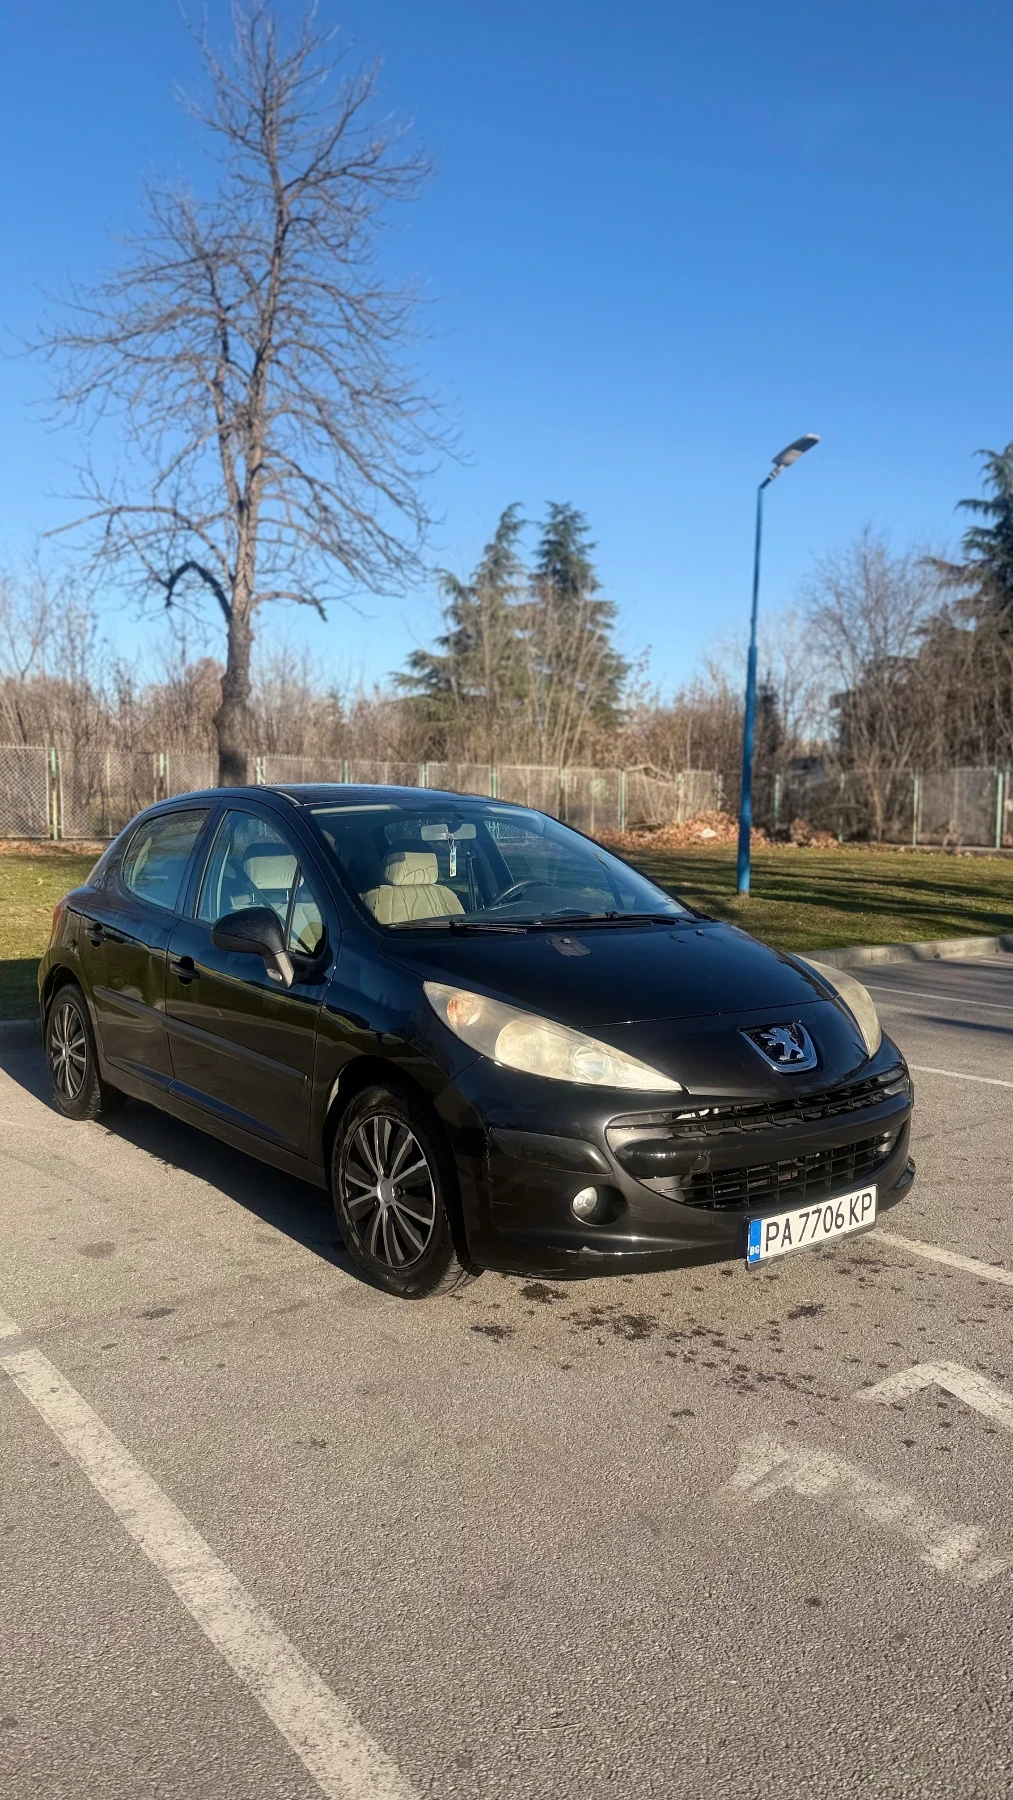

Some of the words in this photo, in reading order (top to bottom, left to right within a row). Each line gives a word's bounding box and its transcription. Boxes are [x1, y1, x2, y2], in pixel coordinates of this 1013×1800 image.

[765, 1218, 792, 1252] PA
[798, 1201, 845, 1242] 7706
[849, 1192, 872, 1226] KP
[750, 1245, 760, 1255] BG
